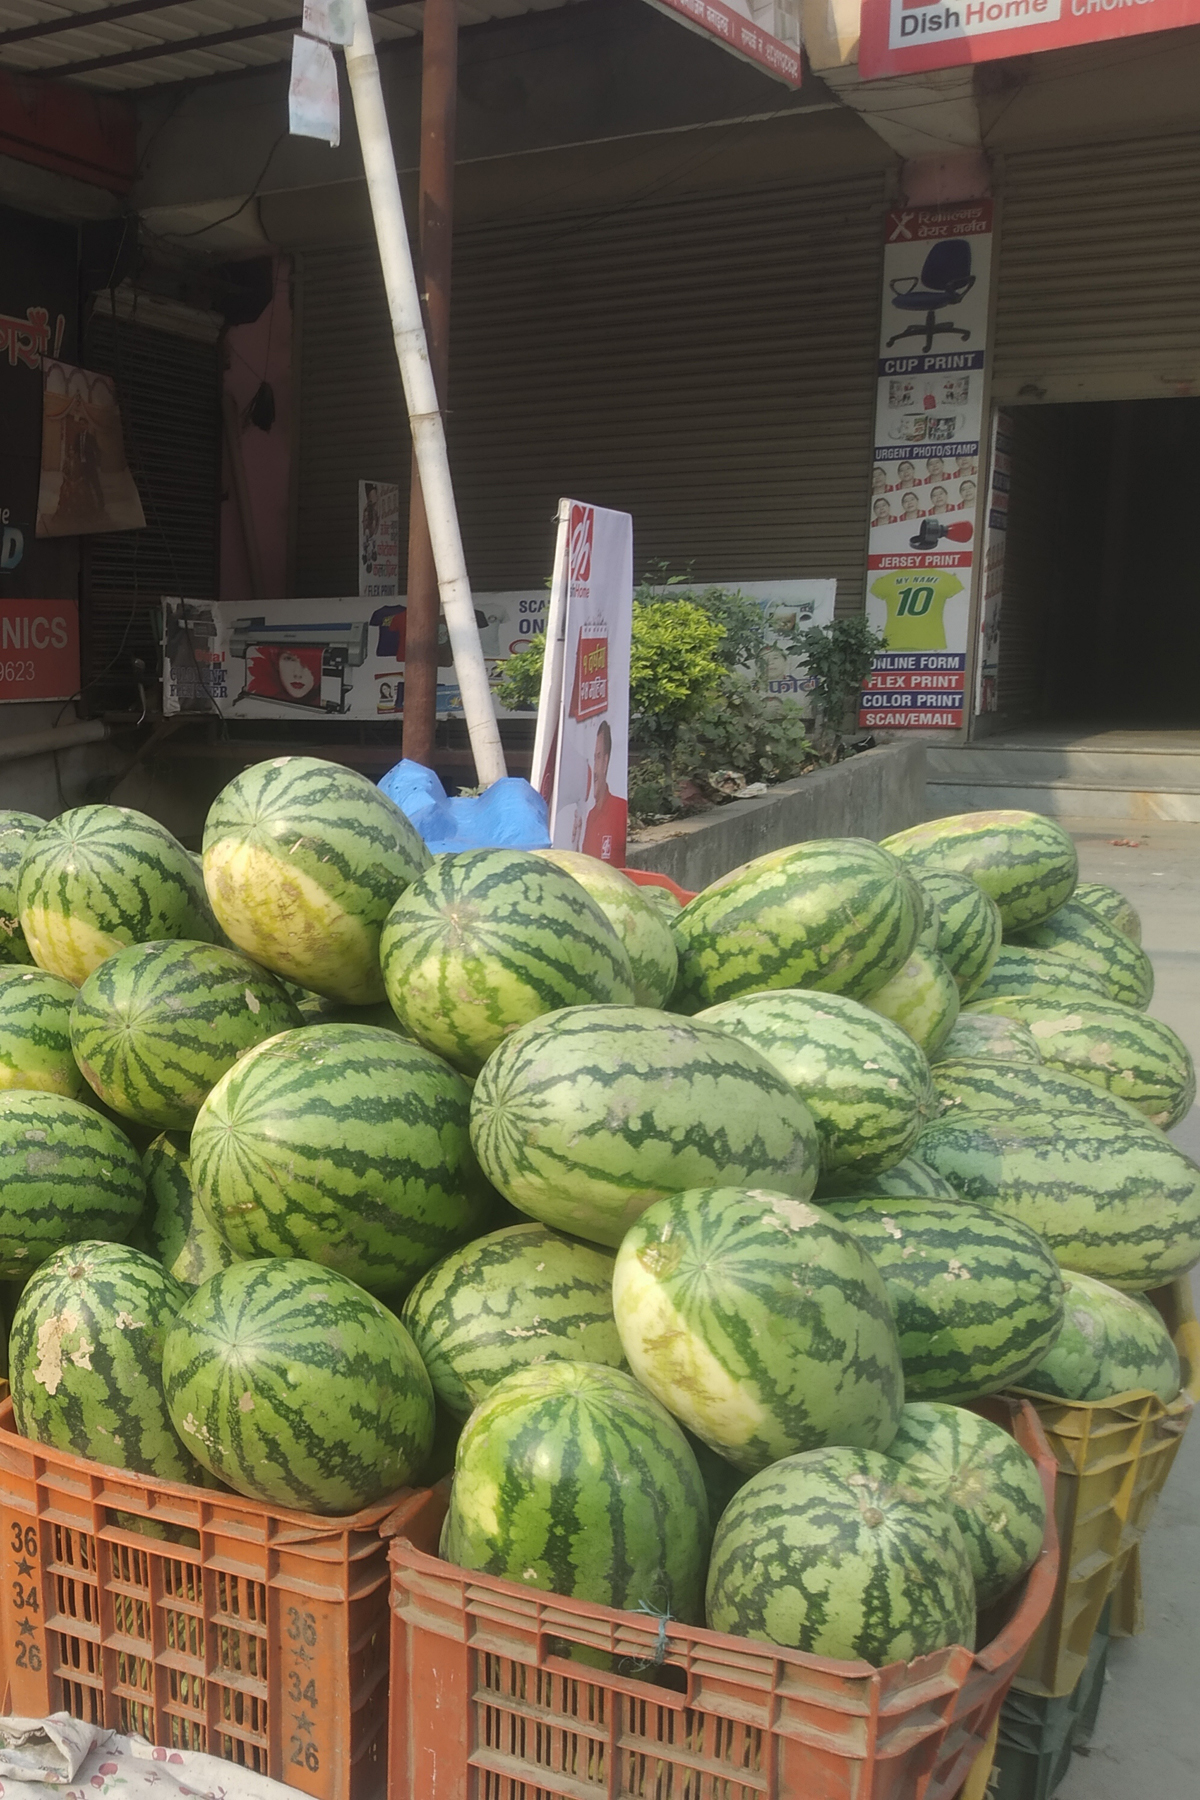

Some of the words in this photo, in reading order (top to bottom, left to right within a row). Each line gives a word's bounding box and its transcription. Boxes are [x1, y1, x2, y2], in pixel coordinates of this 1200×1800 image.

[885, 360, 919, 374] CUP
[924, 354, 976, 370] PRINT
[875, 445, 911, 460] URGENT
[913, 443, 978, 458] PHOTO/STAMP
[878, 555, 922, 568] JERSEY
[925, 554, 961, 567] PRINT
[896, 576, 911, 585] MY
[913, 574, 940, 585] NAME
[896, 587, 934, 617] 10
[920, 655, 960, 669] FORM
[867, 676, 909, 689] FLEX
[910, 675, 959, 689] PRINT
[862, 694, 913, 708] COLOR
[916, 693, 962, 707] PRINT
[866, 712, 957, 727] SCAN/EMAIL
[10, 1521, 38, 1557] 36
[12, 1581, 40, 1613] 34
[286, 1606, 318, 1647] 36
[14, 1640, 42, 1671] 26
[288, 1672, 318, 1709] 34
[290, 1736, 320, 1773] 26
